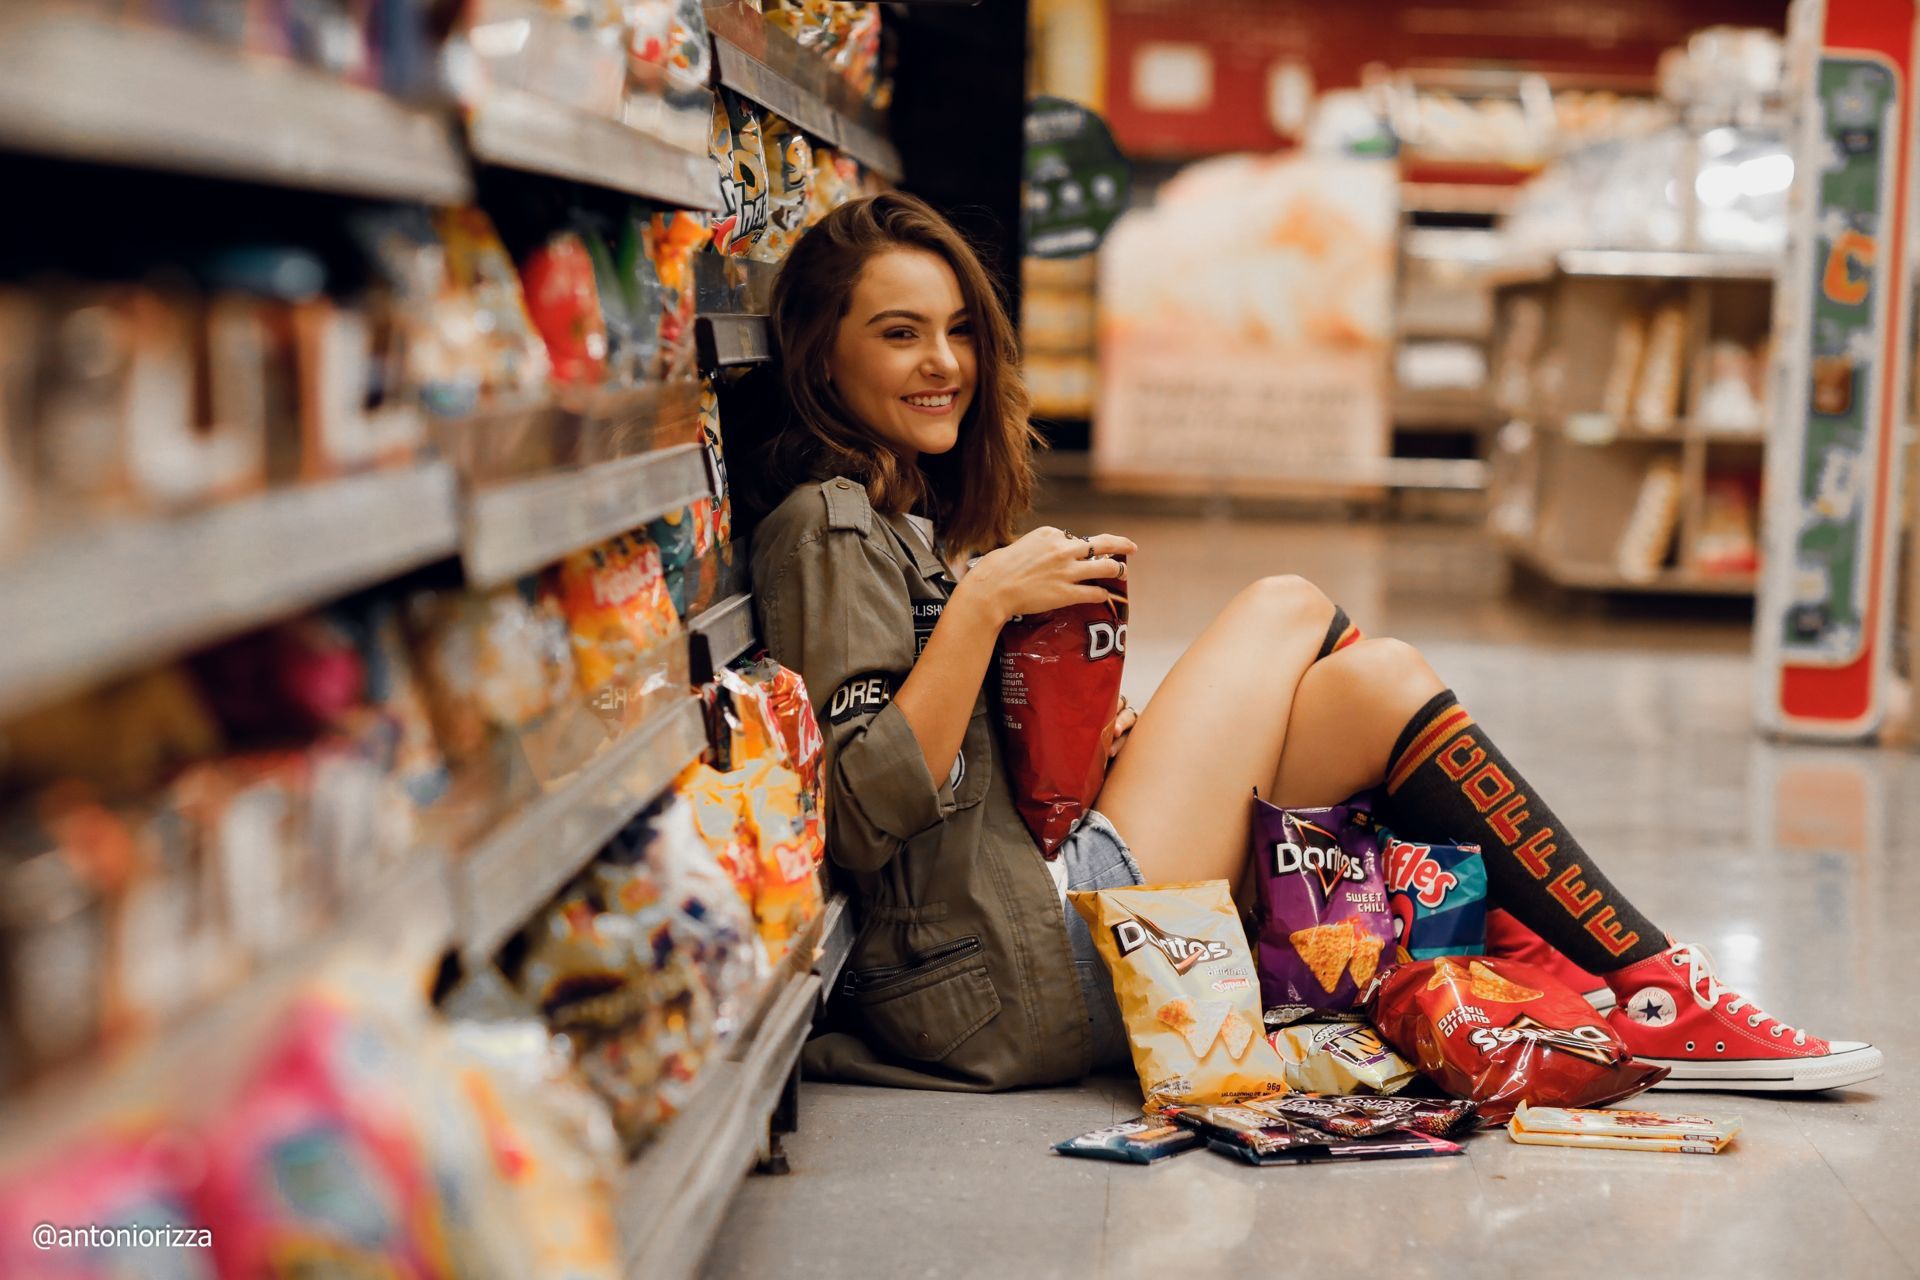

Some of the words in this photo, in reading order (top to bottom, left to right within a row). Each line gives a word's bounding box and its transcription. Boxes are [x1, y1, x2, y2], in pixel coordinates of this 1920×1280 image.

[1435, 735, 1640, 957] COFFEE
[1276, 842, 1365, 880] Doritos
[1345, 892, 1383, 903] SWEET
[1357, 902, 1385, 913] CHILI
[1117, 920, 1229, 962] Doritos
[1438, 1005, 1486, 1032] NACHO
[1444, 1014, 1491, 1039] QUEIJO
[1266, 1082, 1281, 1092] 96g
